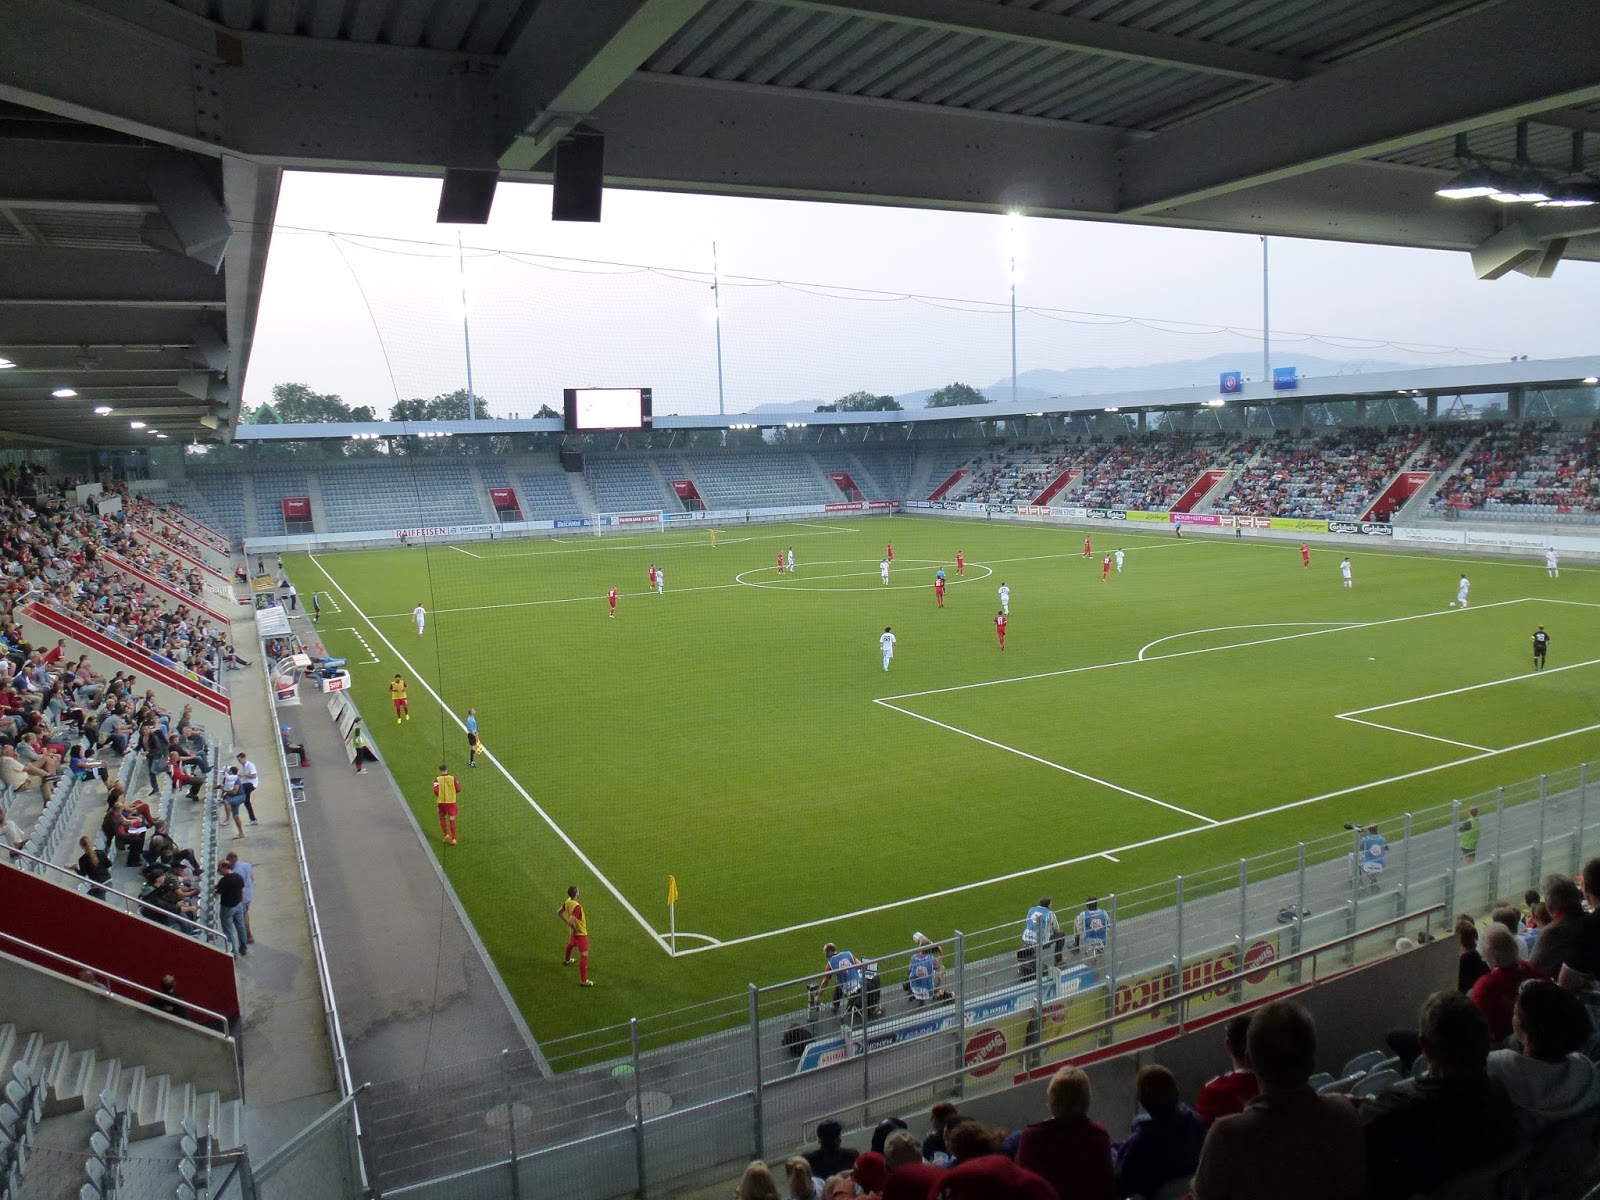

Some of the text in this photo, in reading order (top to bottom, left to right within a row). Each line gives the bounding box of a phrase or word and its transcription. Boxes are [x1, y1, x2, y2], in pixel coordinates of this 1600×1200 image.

[396, 528, 445, 538] RAIFFEISEN
[1329, 522, 1357, 533] Carlsberg
[1362, 524, 1391, 535] Carlsberg
